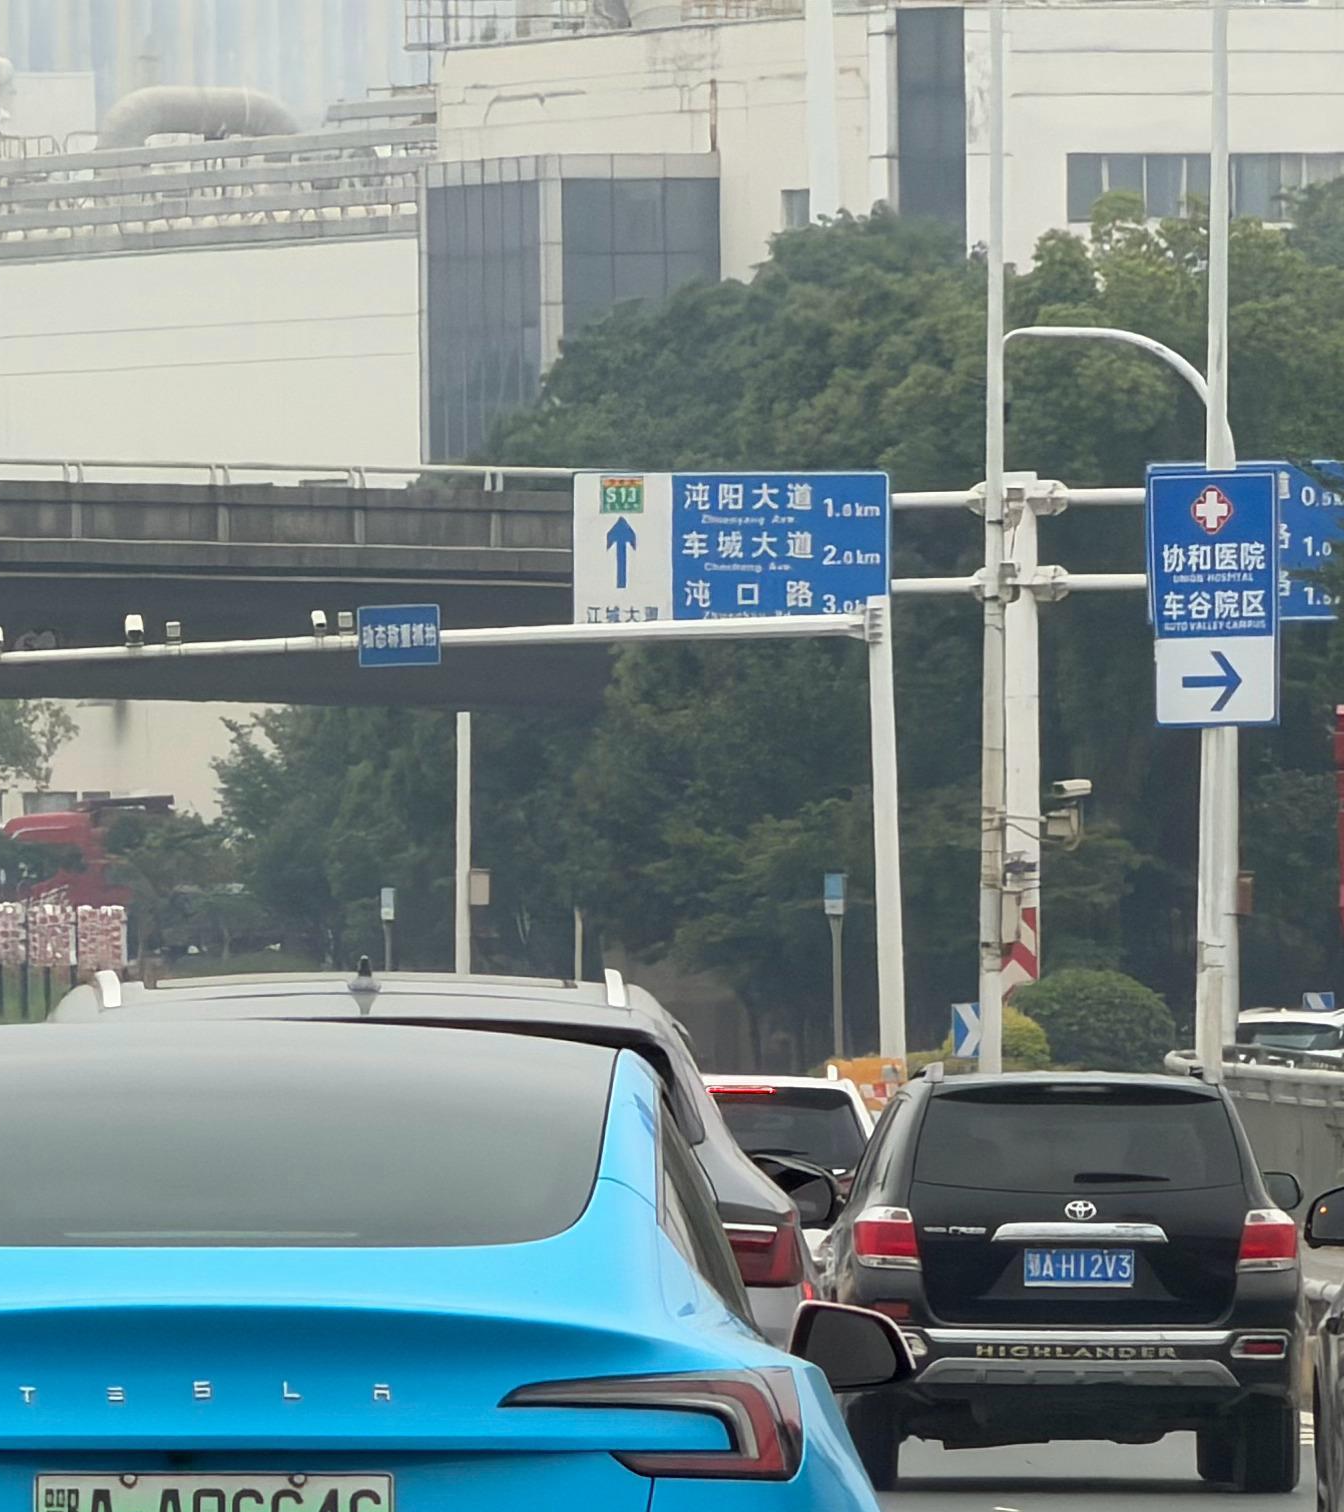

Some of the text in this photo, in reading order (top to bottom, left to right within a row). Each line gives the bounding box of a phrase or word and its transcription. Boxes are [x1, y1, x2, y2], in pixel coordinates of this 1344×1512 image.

[683, 482, 814, 510] 沌阳大道
[682, 531, 814, 559] 车城大道
[1163, 543, 1265, 573] 协和医院
[685, 580, 813, 608] 沌口路
[1163, 590, 1265, 620] 车谷院区
[975, 1345, 1176, 1358] HIGHLANDER
[19, 1381, 391, 1403] TESLA
